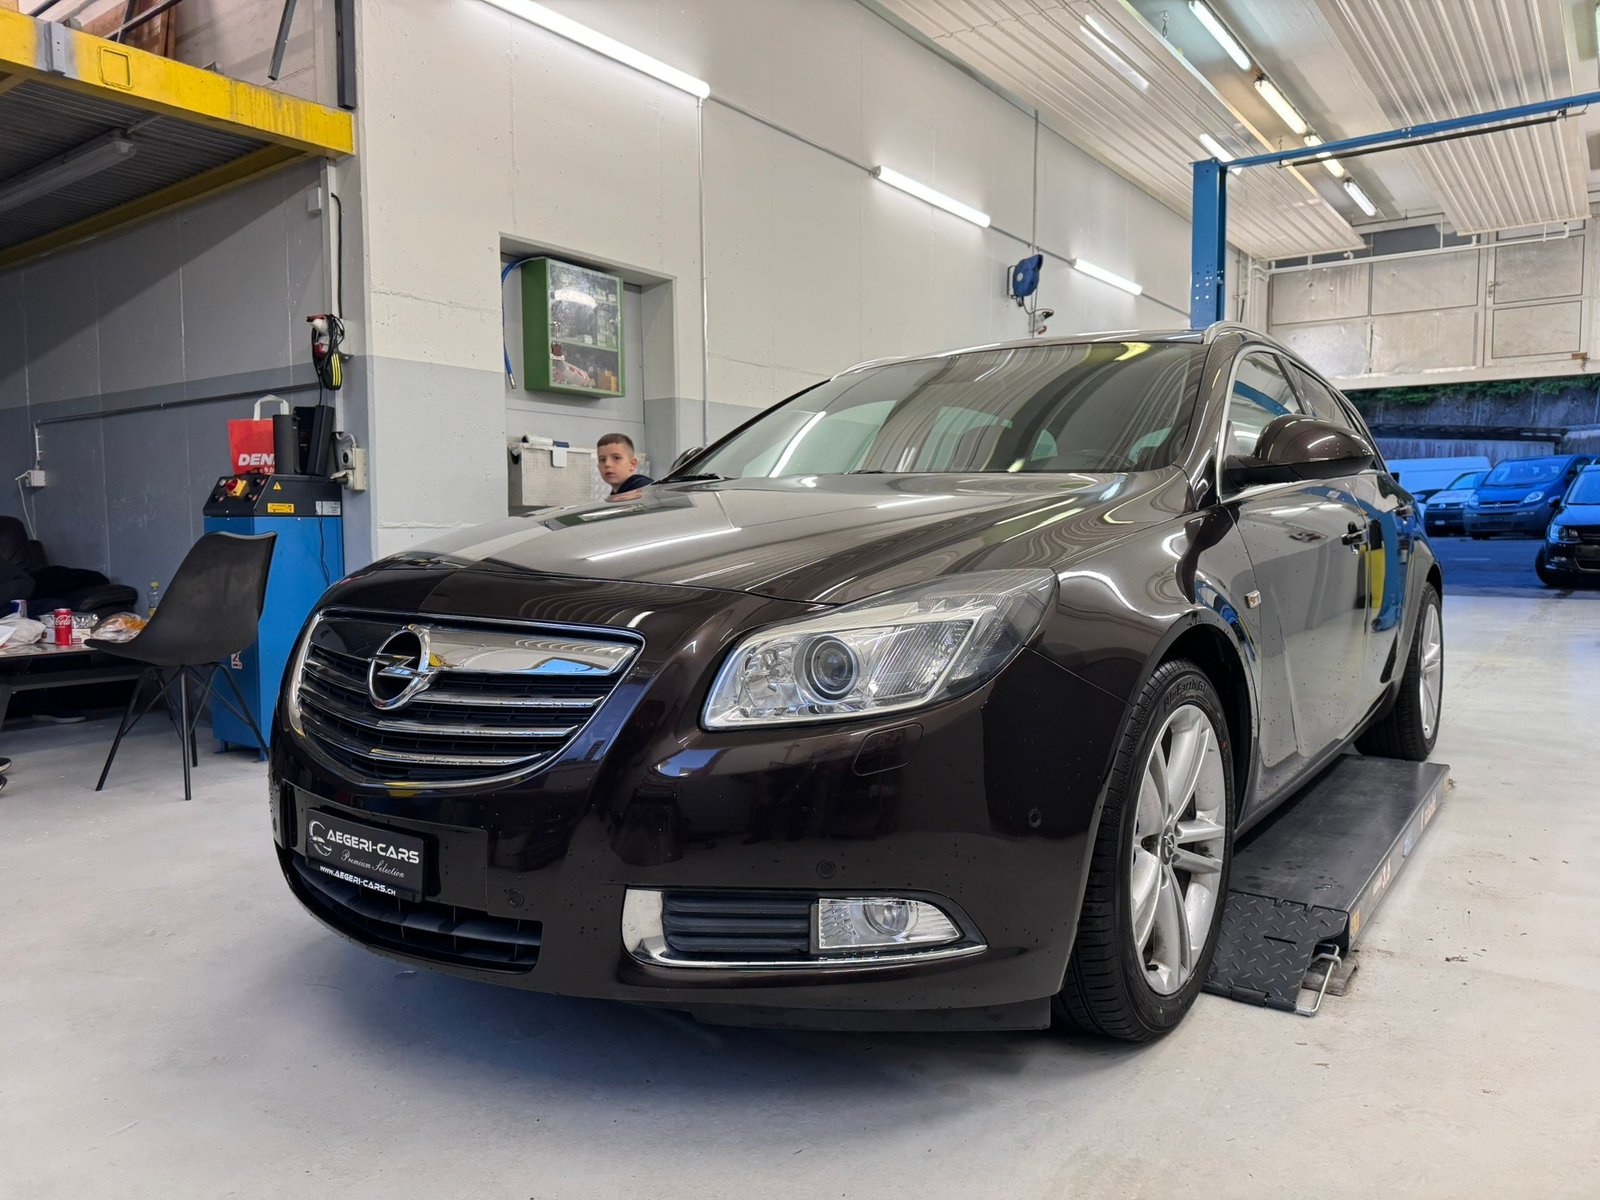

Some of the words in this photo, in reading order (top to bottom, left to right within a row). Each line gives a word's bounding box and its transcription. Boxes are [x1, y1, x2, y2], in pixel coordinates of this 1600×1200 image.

[238, 453, 275, 466] DEN
[326, 829, 420, 864] AEGERI-CARS
[341, 849, 371, 870] Premium
[371, 860, 405, 878] Selection
